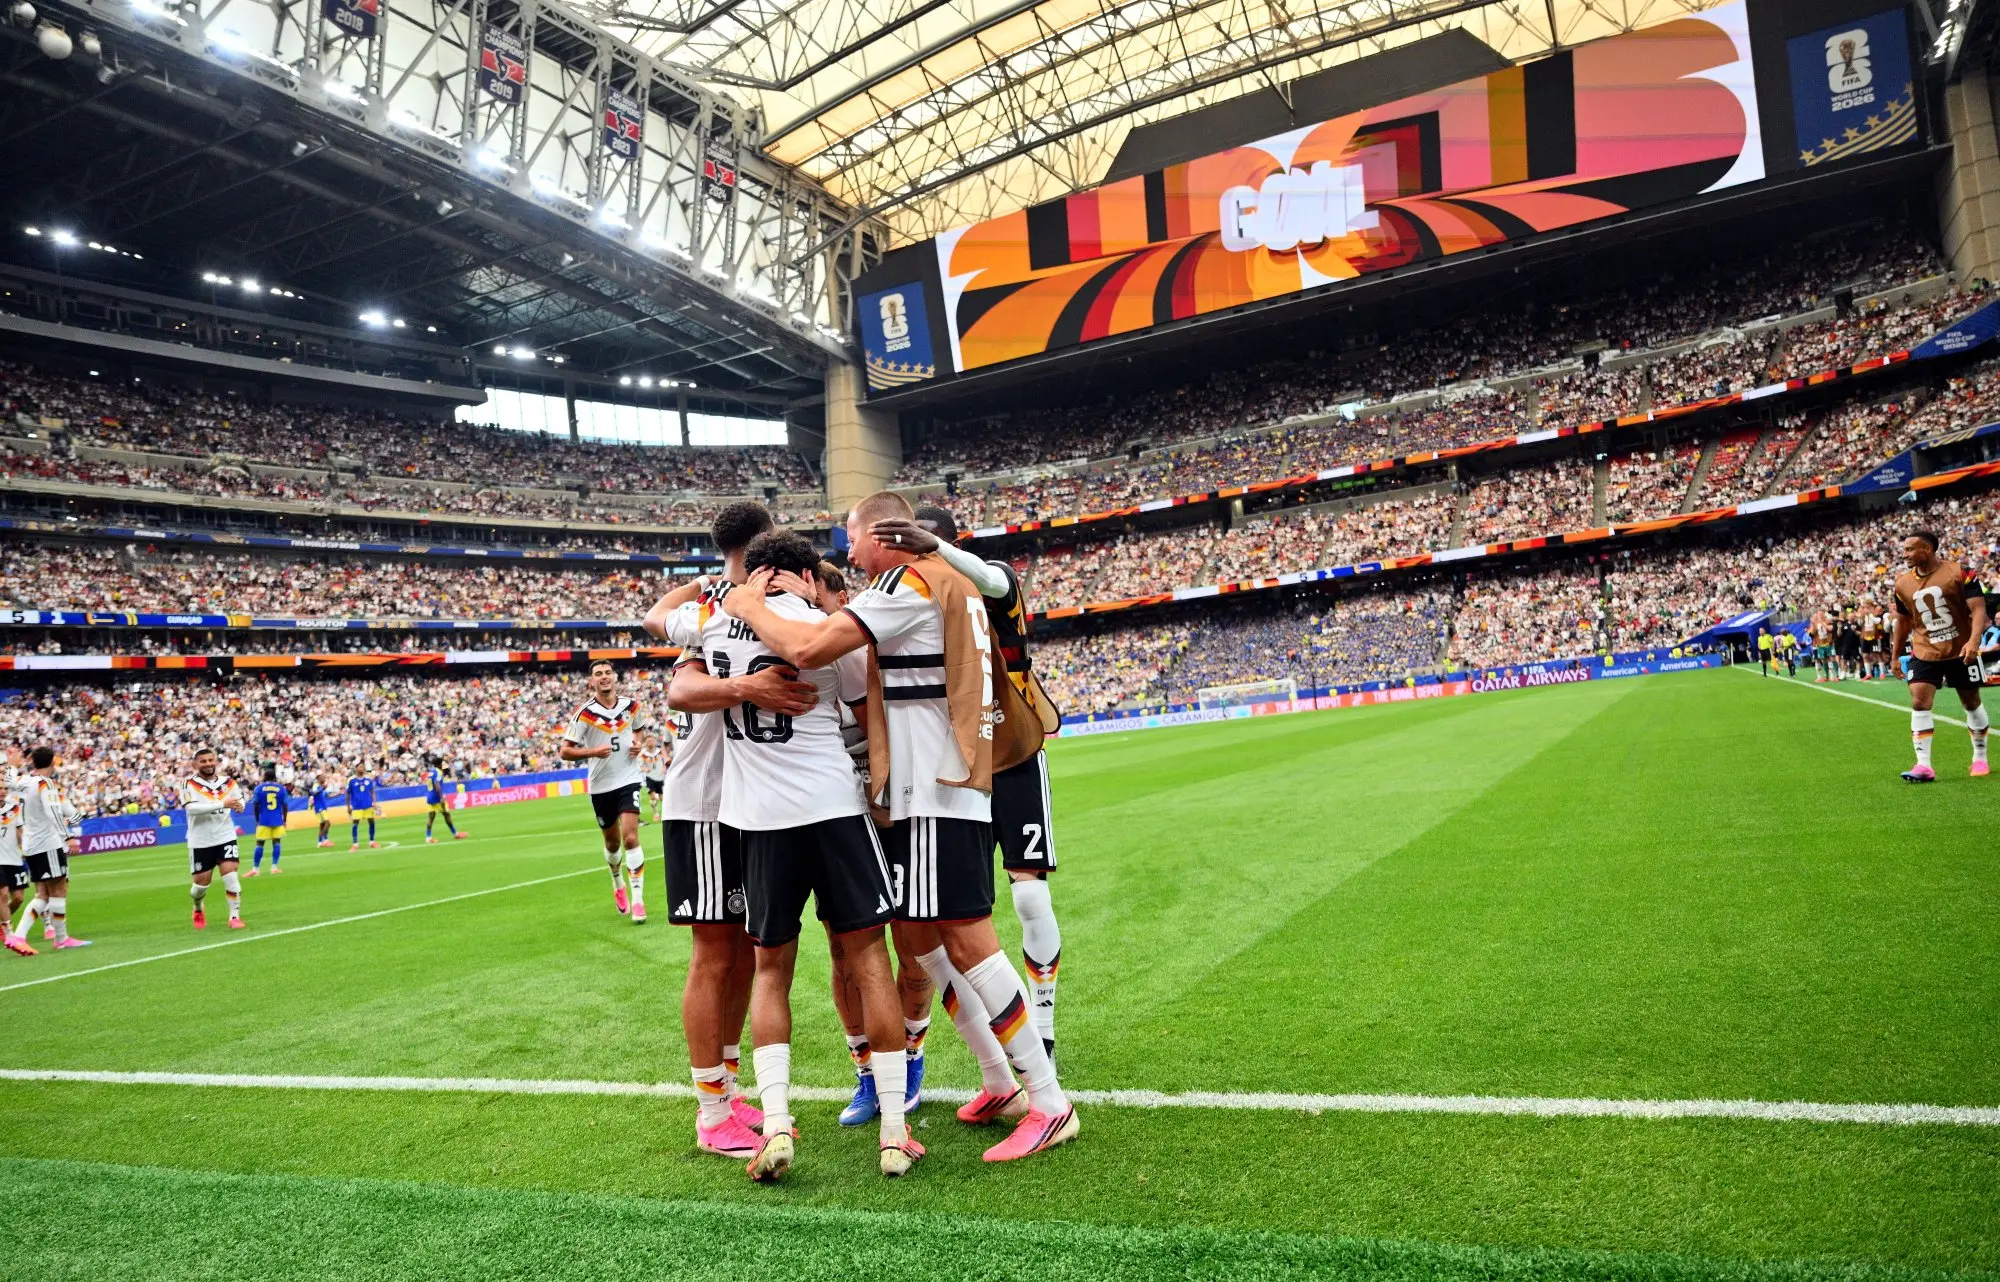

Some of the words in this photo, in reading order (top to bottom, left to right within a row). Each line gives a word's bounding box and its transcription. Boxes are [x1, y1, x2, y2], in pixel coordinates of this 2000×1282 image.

[335, 8, 364, 32] 2018
[490, 79, 514, 99] 2019
[1841, 77, 1861, 87] FIFA
[1831, 90, 1858, 102] WORLD
[1859, 87, 1874, 96] CUP
[1832, 94, 1875, 112] 2026
[12, 611, 24, 623] 5
[51, 610, 65, 624] 1
[296, 619, 348, 627] HOUSTON
[1601, 666, 1638, 677] American
[1660, 660, 1698, 671] American
[1968, 665, 1980, 682] 9
[1472, 675, 1521, 693] QATAR
[1526, 668, 1588, 686] AIRWAYS
[1416, 684, 1443, 699] DEPOT
[1076, 718, 1143, 734] CASAMIGOS
[611, 736, 620, 752] 5
[266, 792, 277, 810] 5
[471, 785, 539, 806] ExpressVPN
[88, 830, 156, 852] AIRWAYS
[1022, 823, 1044, 860] 2
[223, 844, 238, 859] 26
[14, 871, 28, 887] 17
